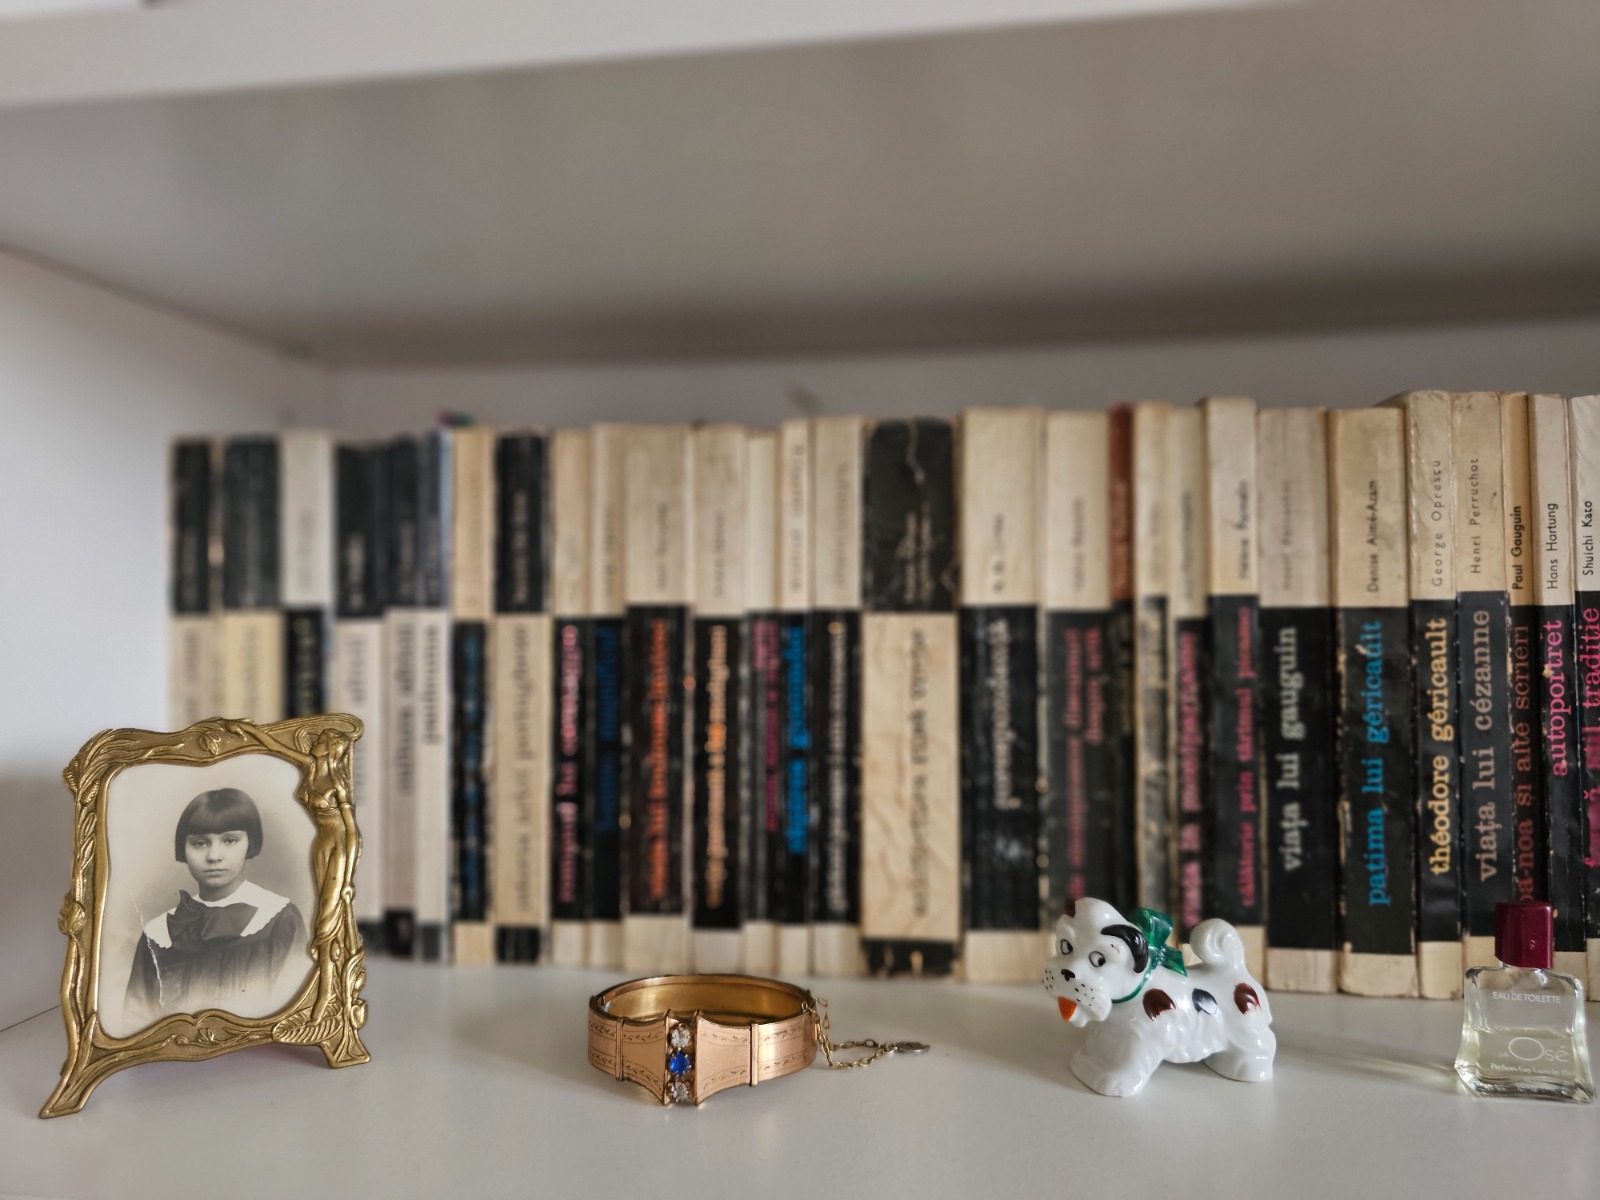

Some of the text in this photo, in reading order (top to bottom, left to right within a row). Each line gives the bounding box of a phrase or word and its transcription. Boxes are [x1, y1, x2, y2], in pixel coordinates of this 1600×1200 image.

[1365, 480, 1379, 593] Denise Aimé-Azam
[1432, 532, 1446, 587] George
[1468, 458, 1481, 574] Henri Perruchot
[1510, 505, 1525, 590] Paul Gauguin
[1545, 502, 1559, 589] Hans Hartung
[1581, 500, 1594, 576] Shuichi Kato
[1514, 624, 1531, 710] scrieri
[1543, 619, 1572, 777] autoportret
[1274, 626, 1309, 871] viața lui gauguin
[1360, 620, 1391, 906] patima lui géricault
[1425, 617, 1455, 875] théodore géricault
[1469, 609, 1502, 882] viața lui cézanne
[1513, 722, 1532, 772] alte
[1492, 991, 1561, 1004] EAU DE TOILETTE
